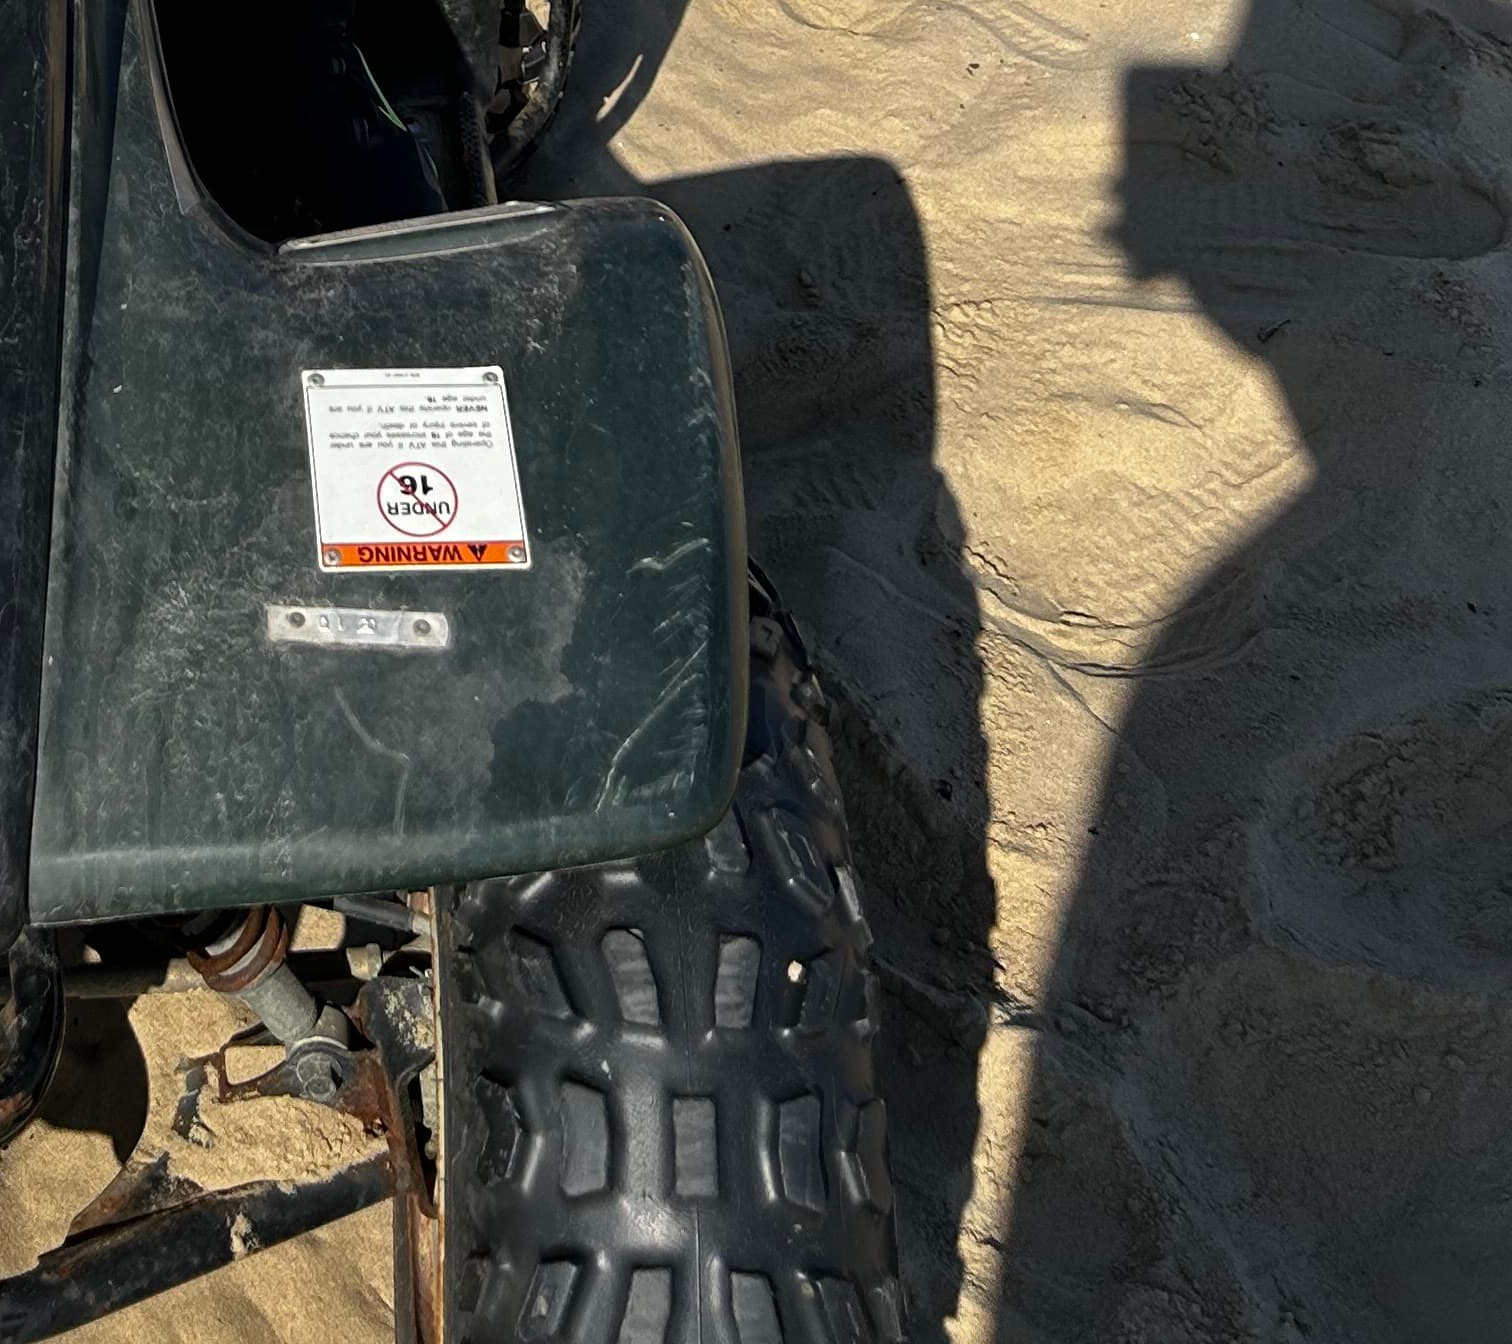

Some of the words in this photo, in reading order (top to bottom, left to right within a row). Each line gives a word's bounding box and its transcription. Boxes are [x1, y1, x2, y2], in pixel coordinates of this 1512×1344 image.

[377, 405, 395, 413] ATV
[422, 421, 446, 429] injury
[329, 431, 360, 439] chance
[457, 430, 474, 438] age
[377, 441, 394, 449] you
[399, 475, 434, 496] 16
[386, 500, 451, 516] UNDER
[358, 544, 463, 563] WARNING
